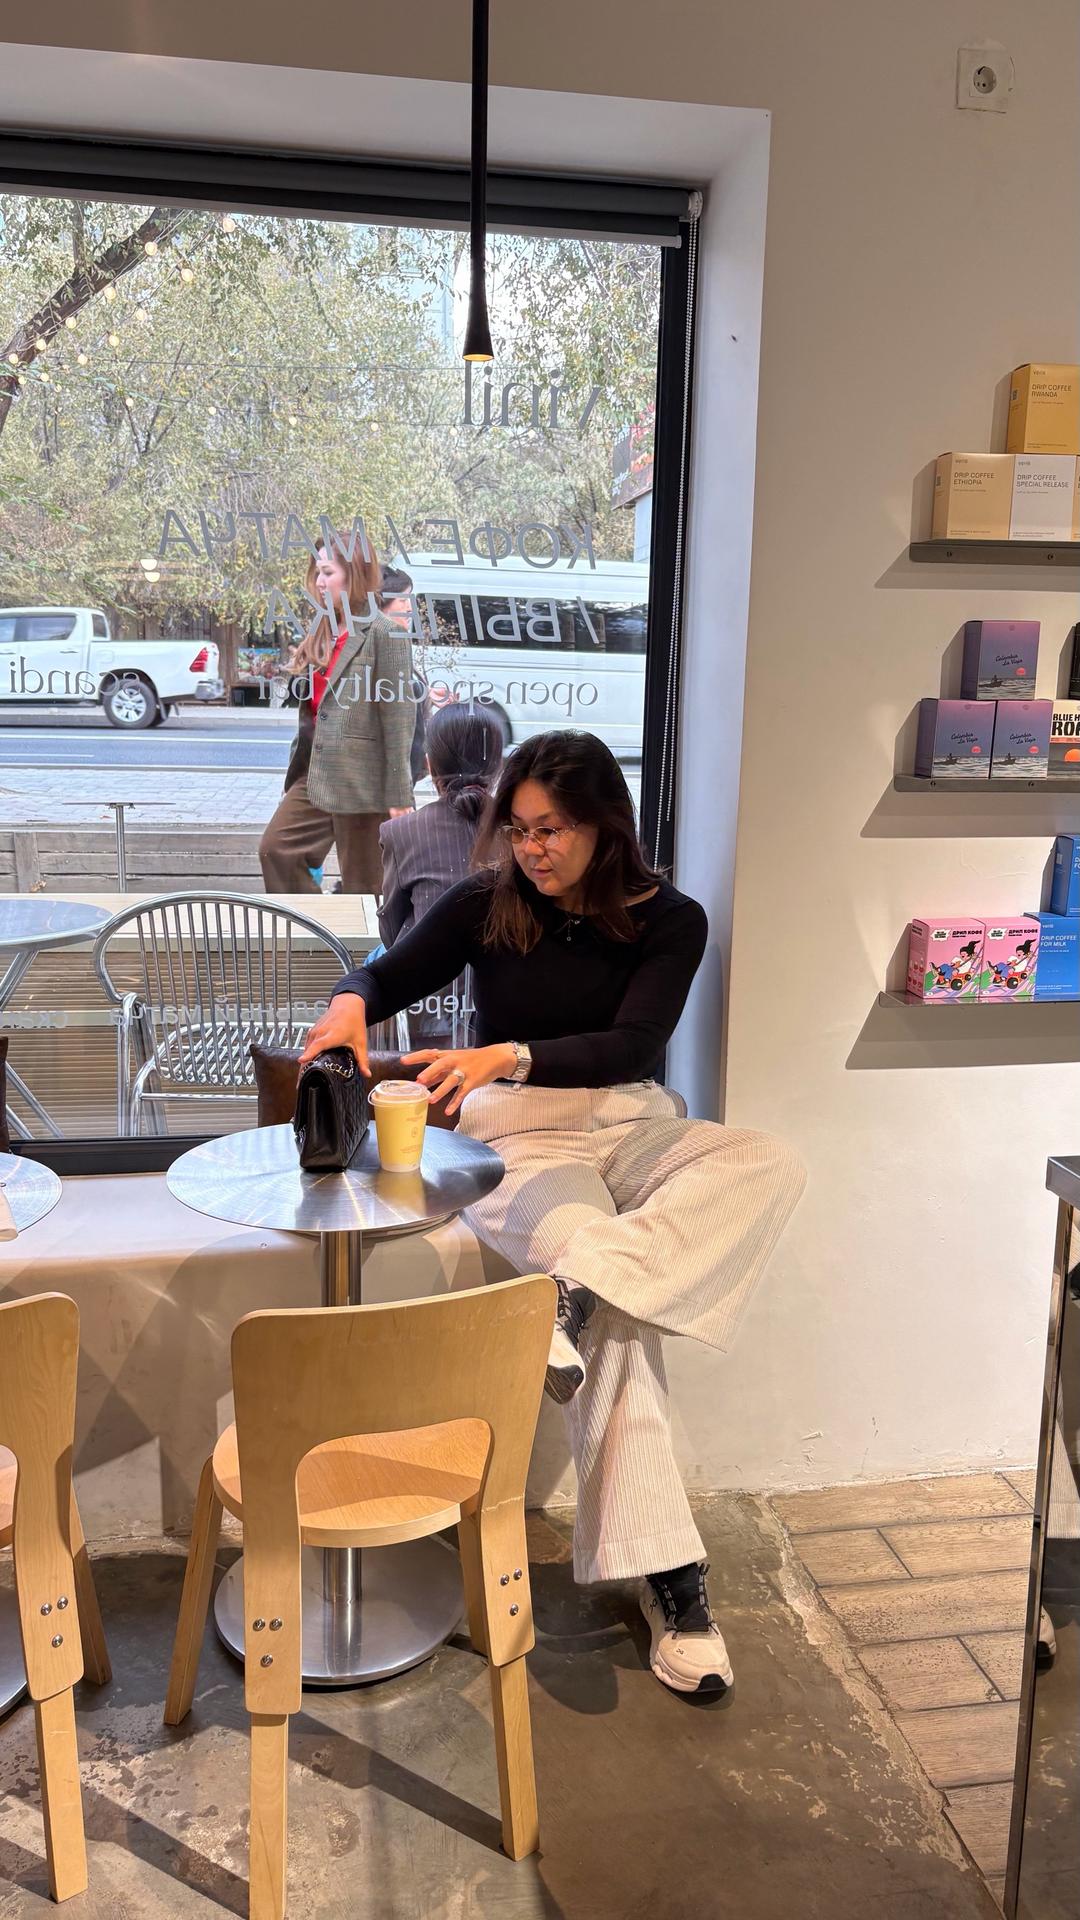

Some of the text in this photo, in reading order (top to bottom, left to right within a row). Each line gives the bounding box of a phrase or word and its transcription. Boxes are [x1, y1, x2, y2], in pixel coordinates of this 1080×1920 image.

[1031, 383, 1072, 392] DRIP COFFEE
[1016, 480, 1042, 488] SPECIAL
[1053, 713, 1073, 721] BLUE
